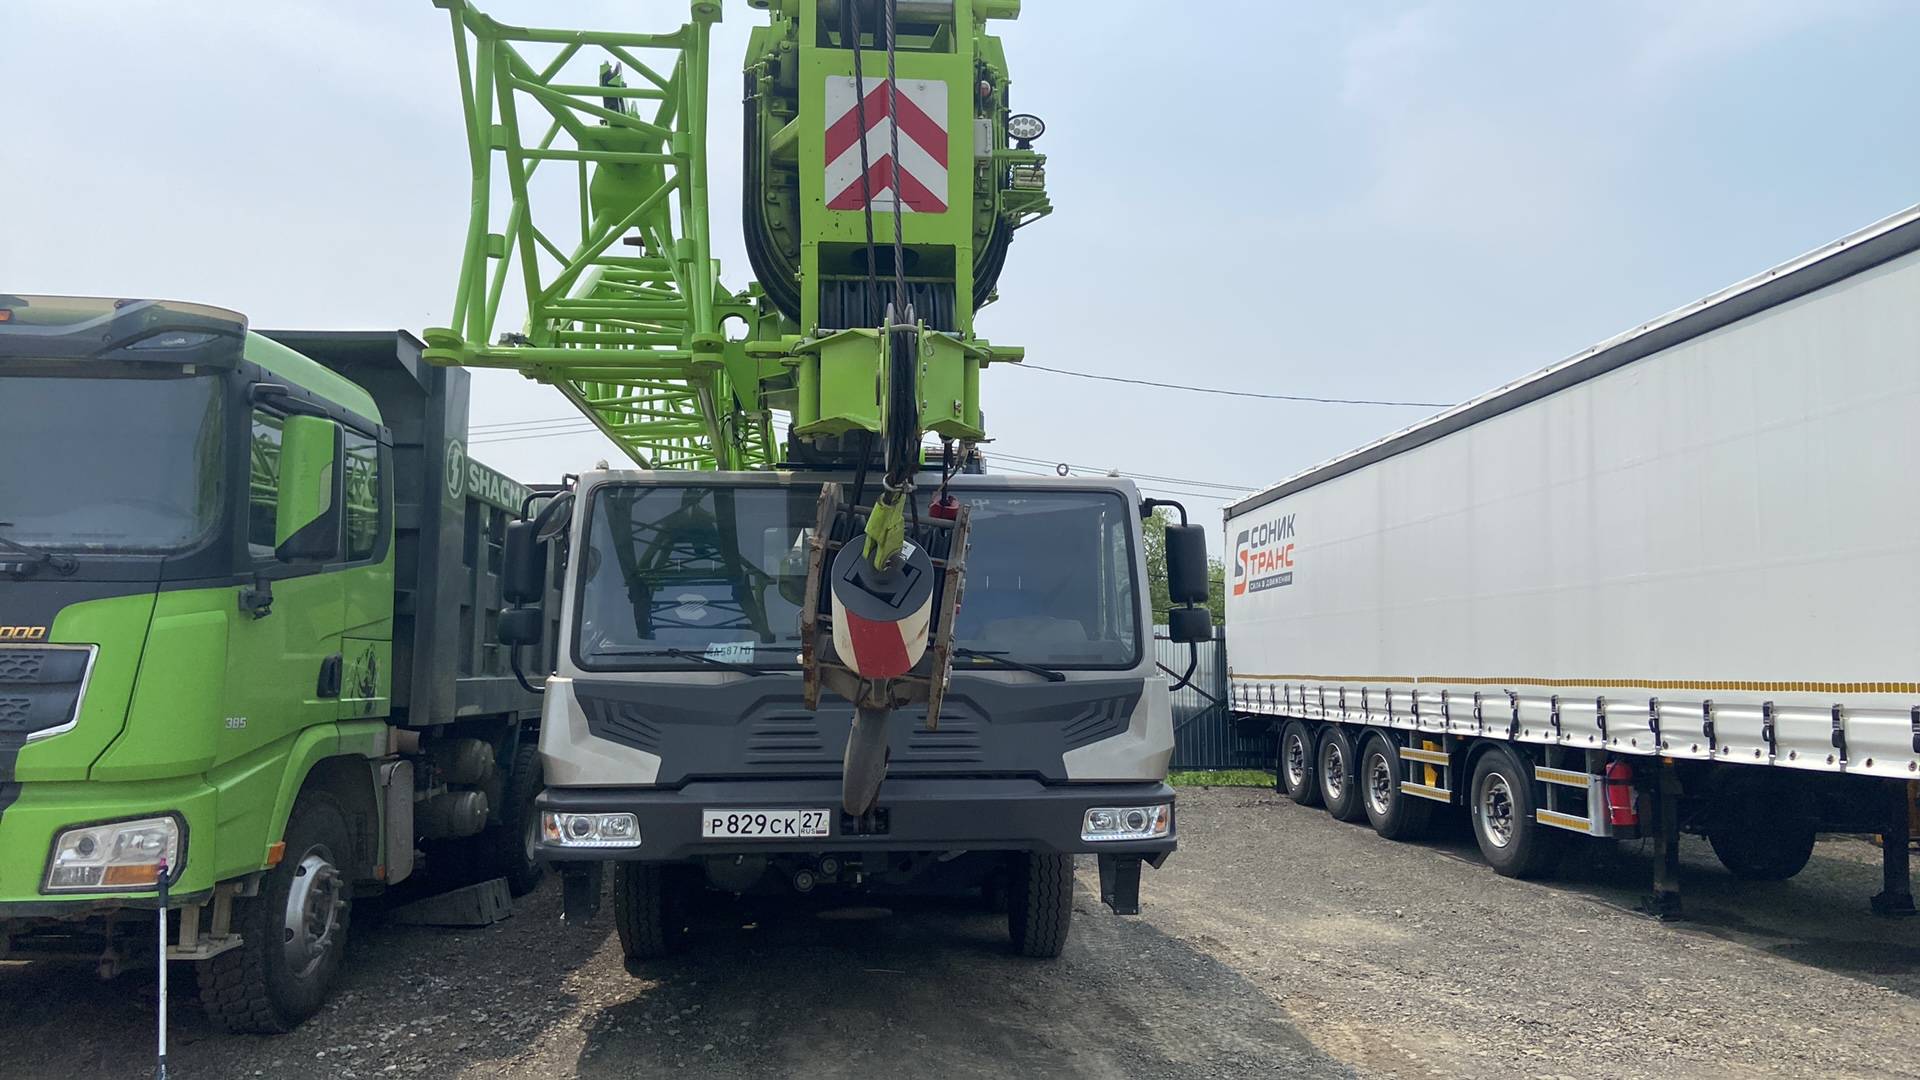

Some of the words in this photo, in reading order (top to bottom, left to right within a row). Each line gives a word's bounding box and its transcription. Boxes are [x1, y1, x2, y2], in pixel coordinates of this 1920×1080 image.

[1251, 513, 1296, 549] СОНИК
[1250, 543, 1294, 575] ТРАНС
[225, 717, 247, 729] 385
[802, 813, 823, 828] 27
